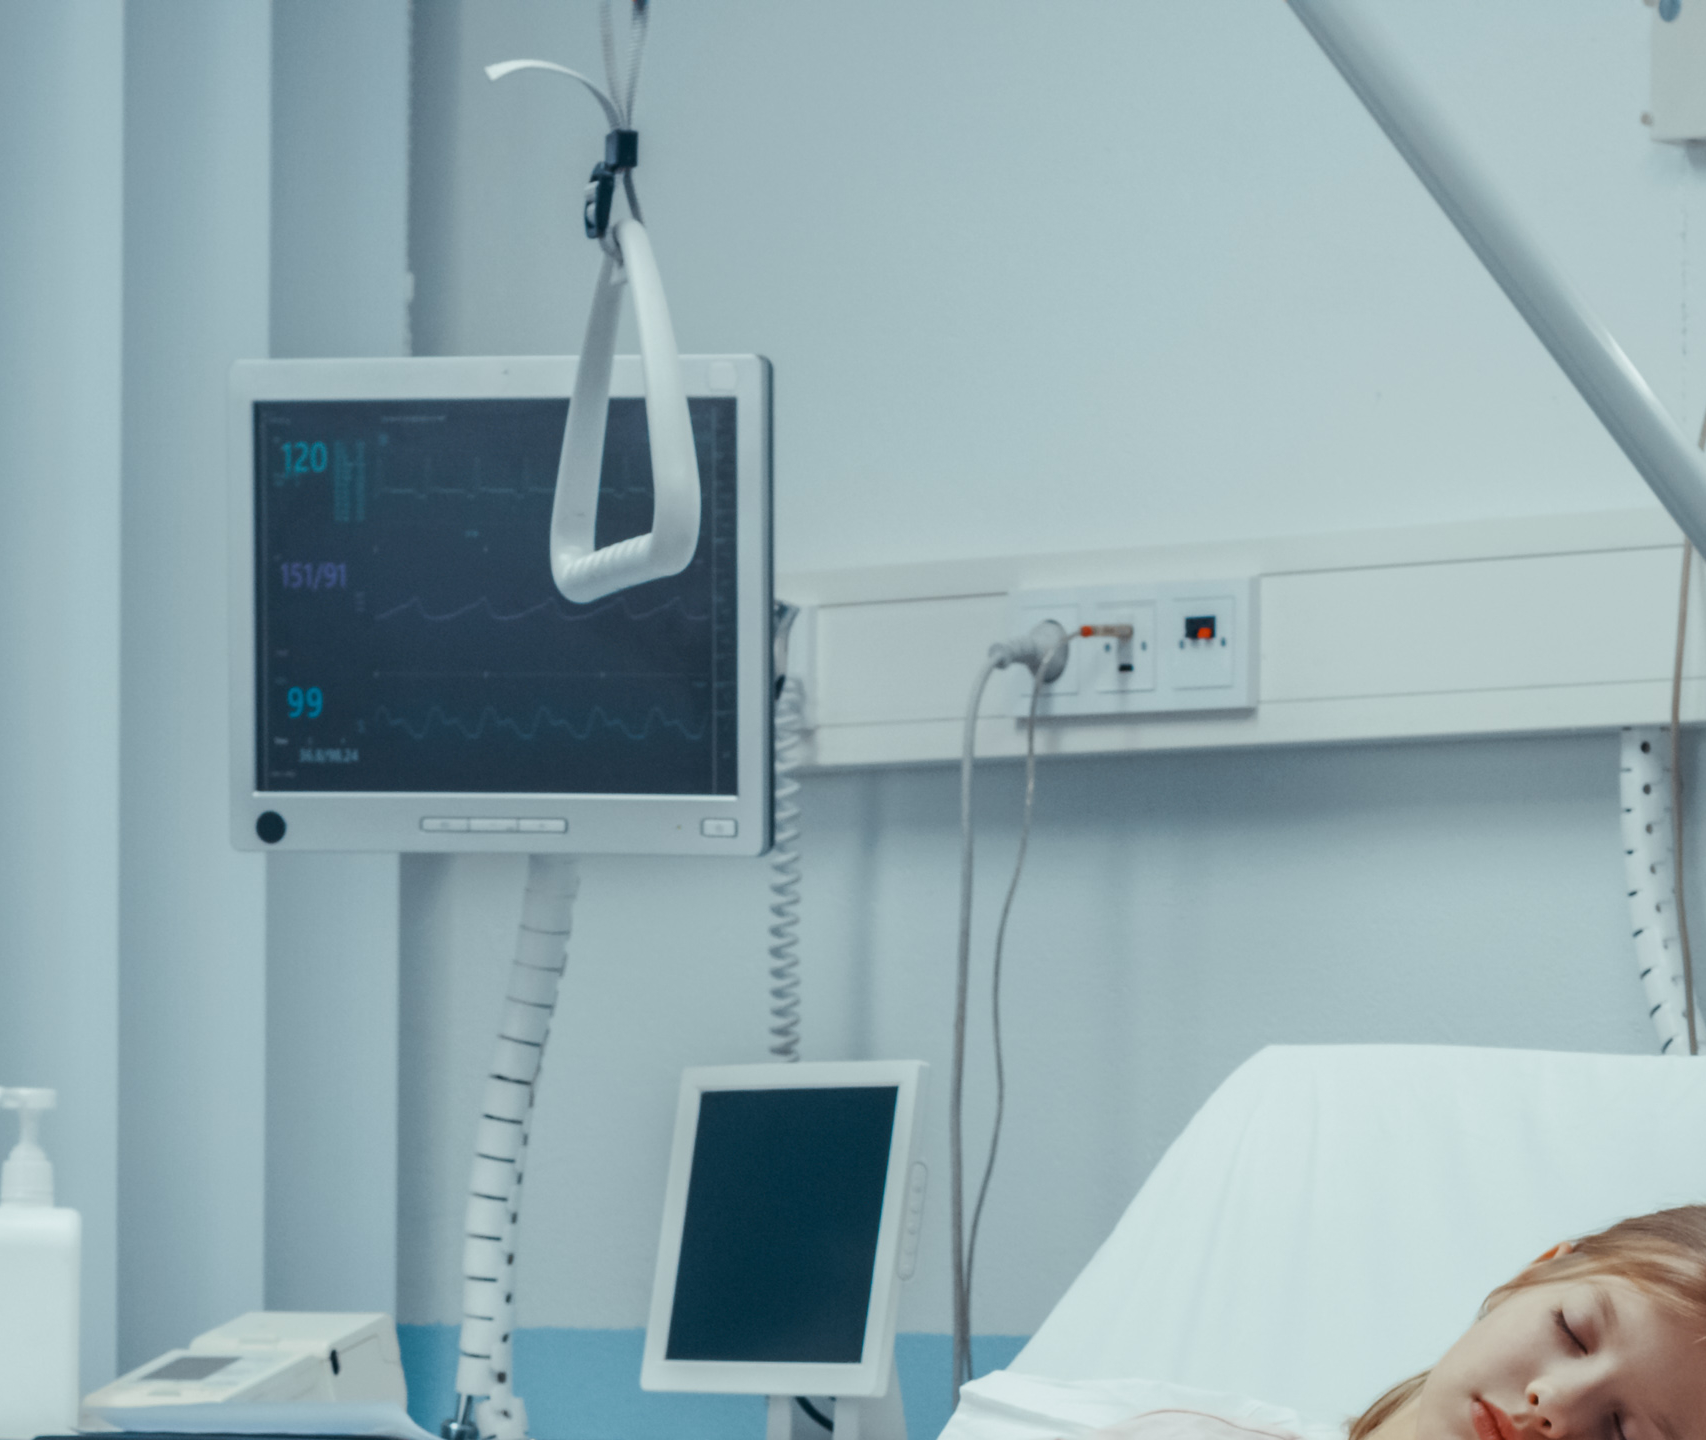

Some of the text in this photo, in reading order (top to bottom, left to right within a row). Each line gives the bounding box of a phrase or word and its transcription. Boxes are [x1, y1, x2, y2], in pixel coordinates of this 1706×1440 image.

[281, 441, 328, 473] 120
[280, 562, 347, 590] 151/91
[287, 686, 323, 718] 99
